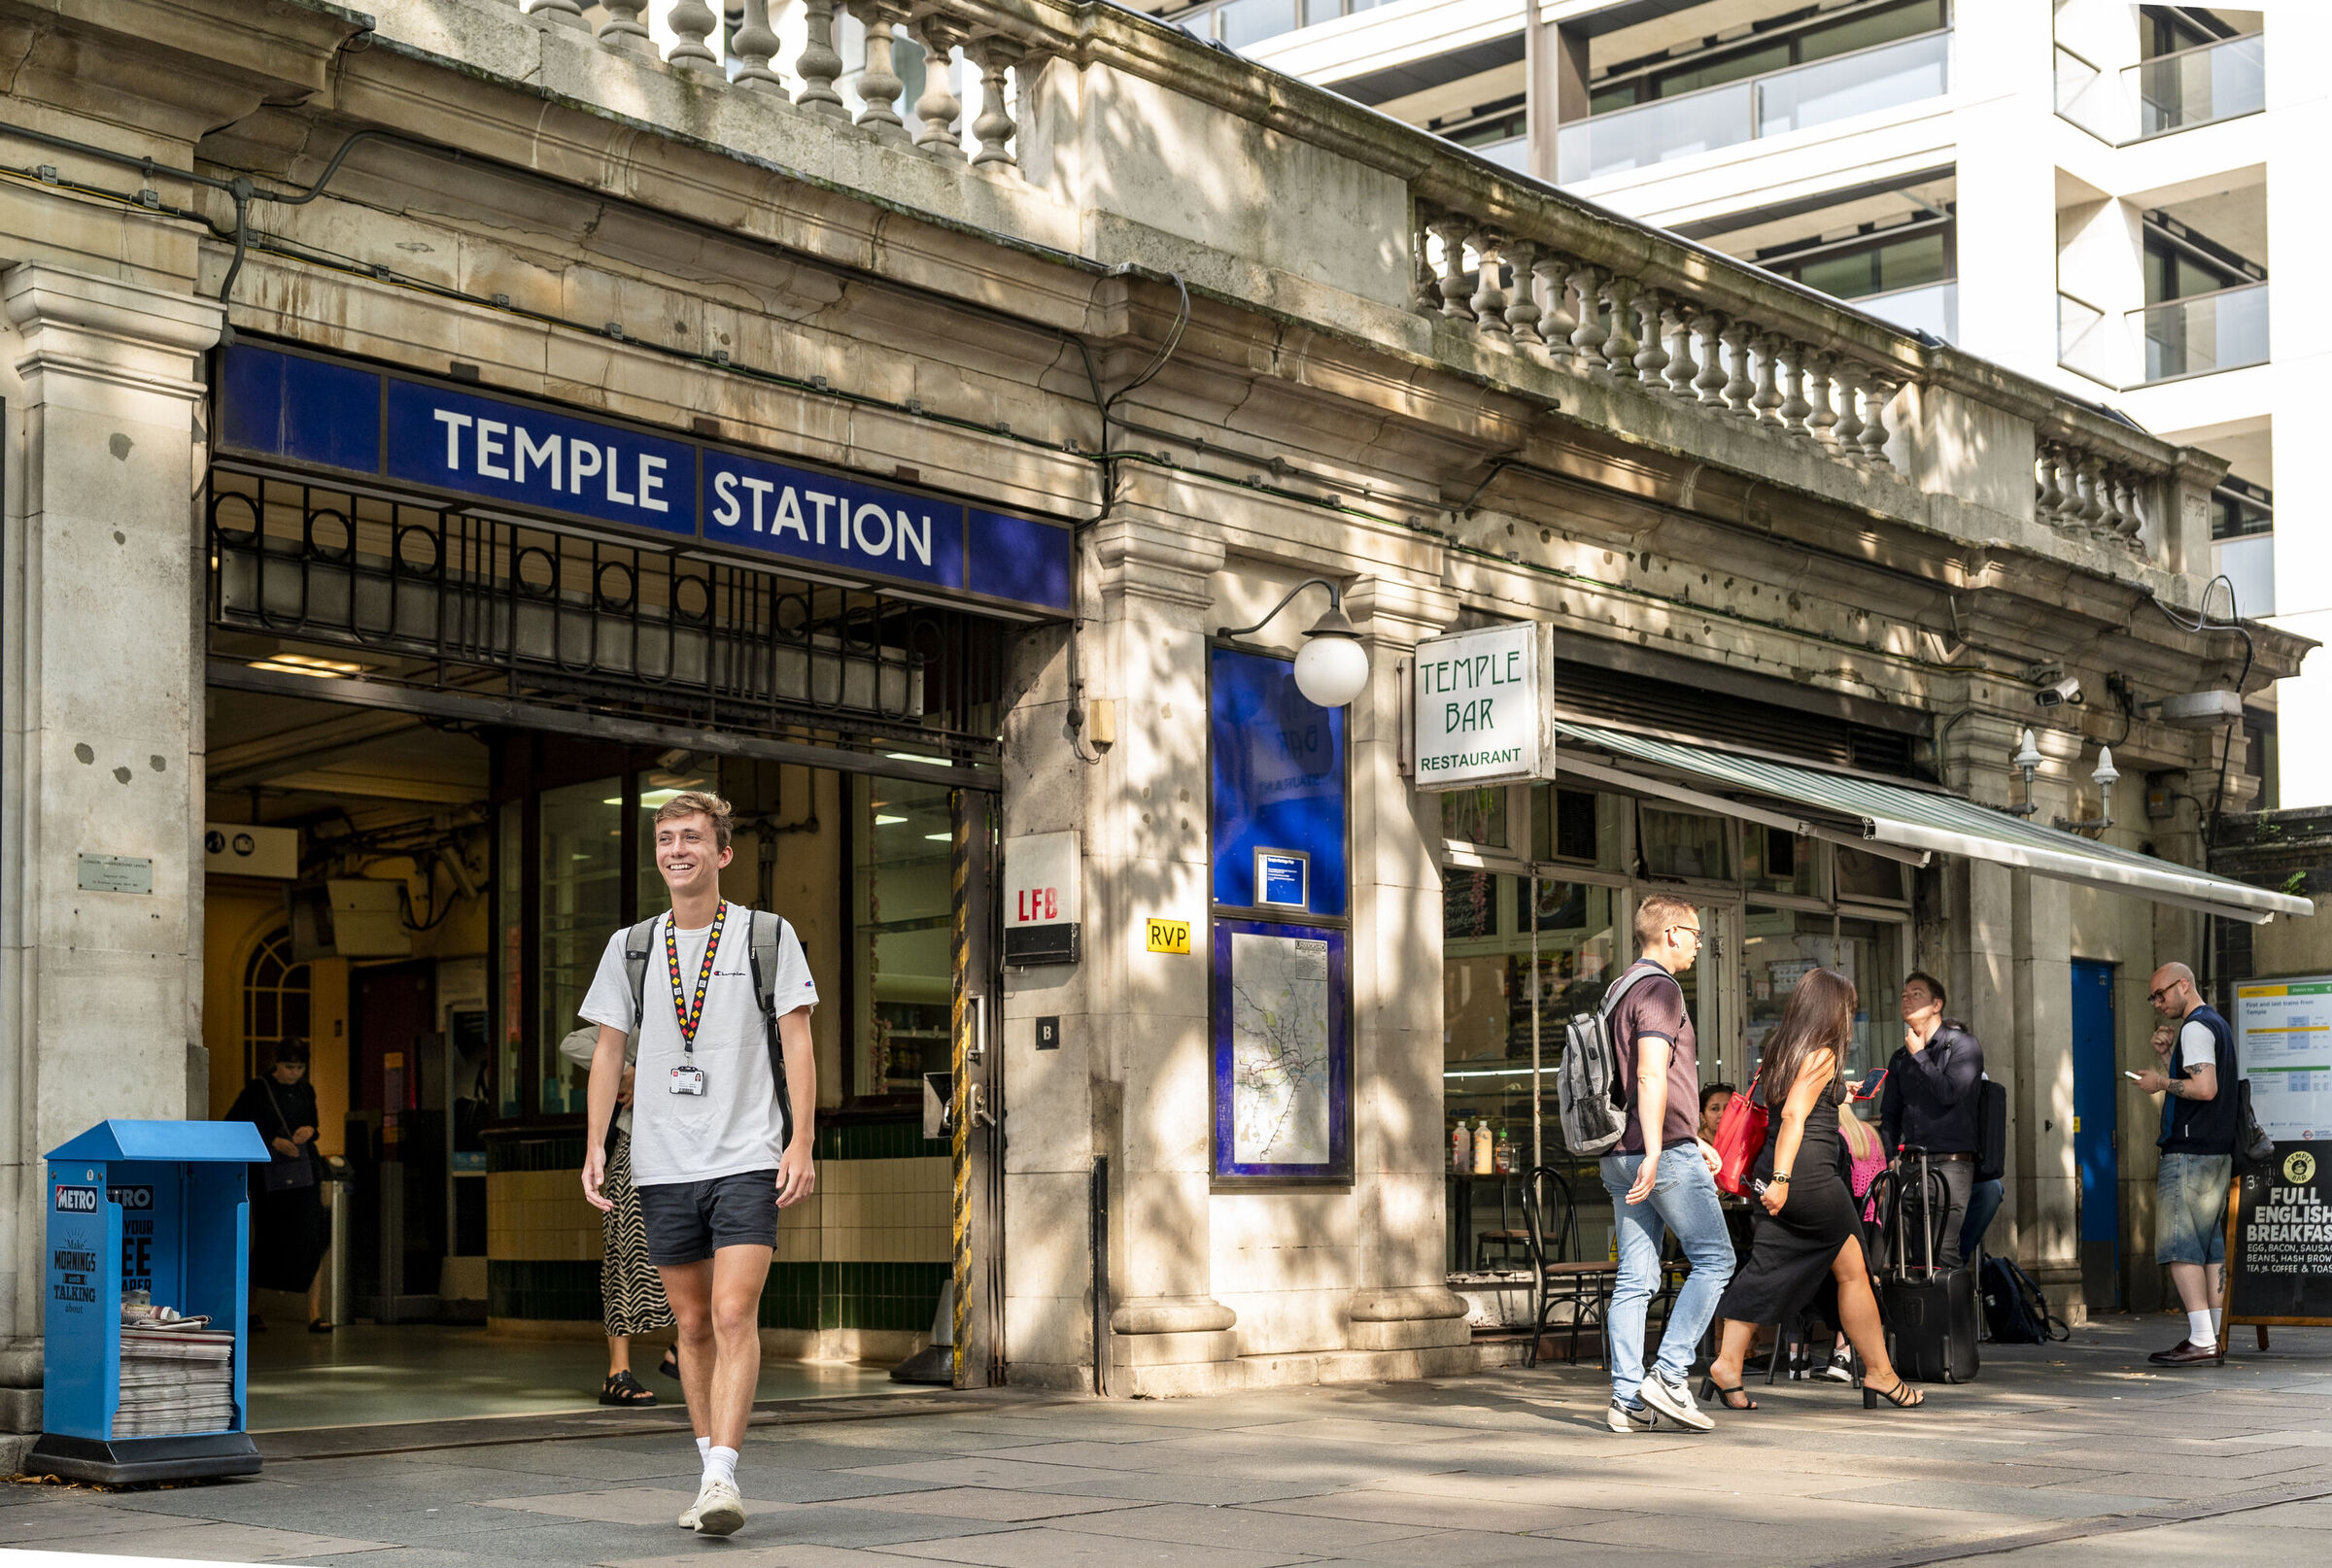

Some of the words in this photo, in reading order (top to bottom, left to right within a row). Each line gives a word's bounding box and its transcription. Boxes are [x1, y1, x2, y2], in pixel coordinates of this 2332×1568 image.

[433, 408, 669, 513] TEMPLE
[712, 470, 932, 566] STATION
[1420, 650, 1522, 695] TEMPLE
[1446, 699, 1494, 734] BAR
[1421, 747, 1522, 771] RESTAURANT
[1018, 887, 1058, 922] LFB
[1151, 925, 1186, 947] RVP
[1043, 1025, 1051, 1040] B
[2286, 1153, 2314, 1166] TEMPLE
[57, 1189, 96, 1210] METRO
[2270, 1186, 2320, 1205] FULL
[2254, 1206, 2332, 1223] ENGLISH
[123, 1219, 154, 1235] YOUR
[66, 1239, 85, 1250] Make
[2246, 1244, 2267, 1253] EGG,
[2268, 1244, 2299, 1253] BACON,
[54, 1250, 96, 1273] MORNINGS
[121, 1237, 152, 1277] EE
[2246, 1253, 2279, 1263] BEANS,
[2281, 1254, 2305, 1263] HASH
[2246, 1264, 2260, 1273] TEA
[2271, 1264, 2298, 1273] COFFEE
[2301, 1264, 2310, 1273] &
[53, 1284, 96, 1303] TALKING
[121, 1278, 152, 1291] APER
[64, 1303, 84, 1313] about
